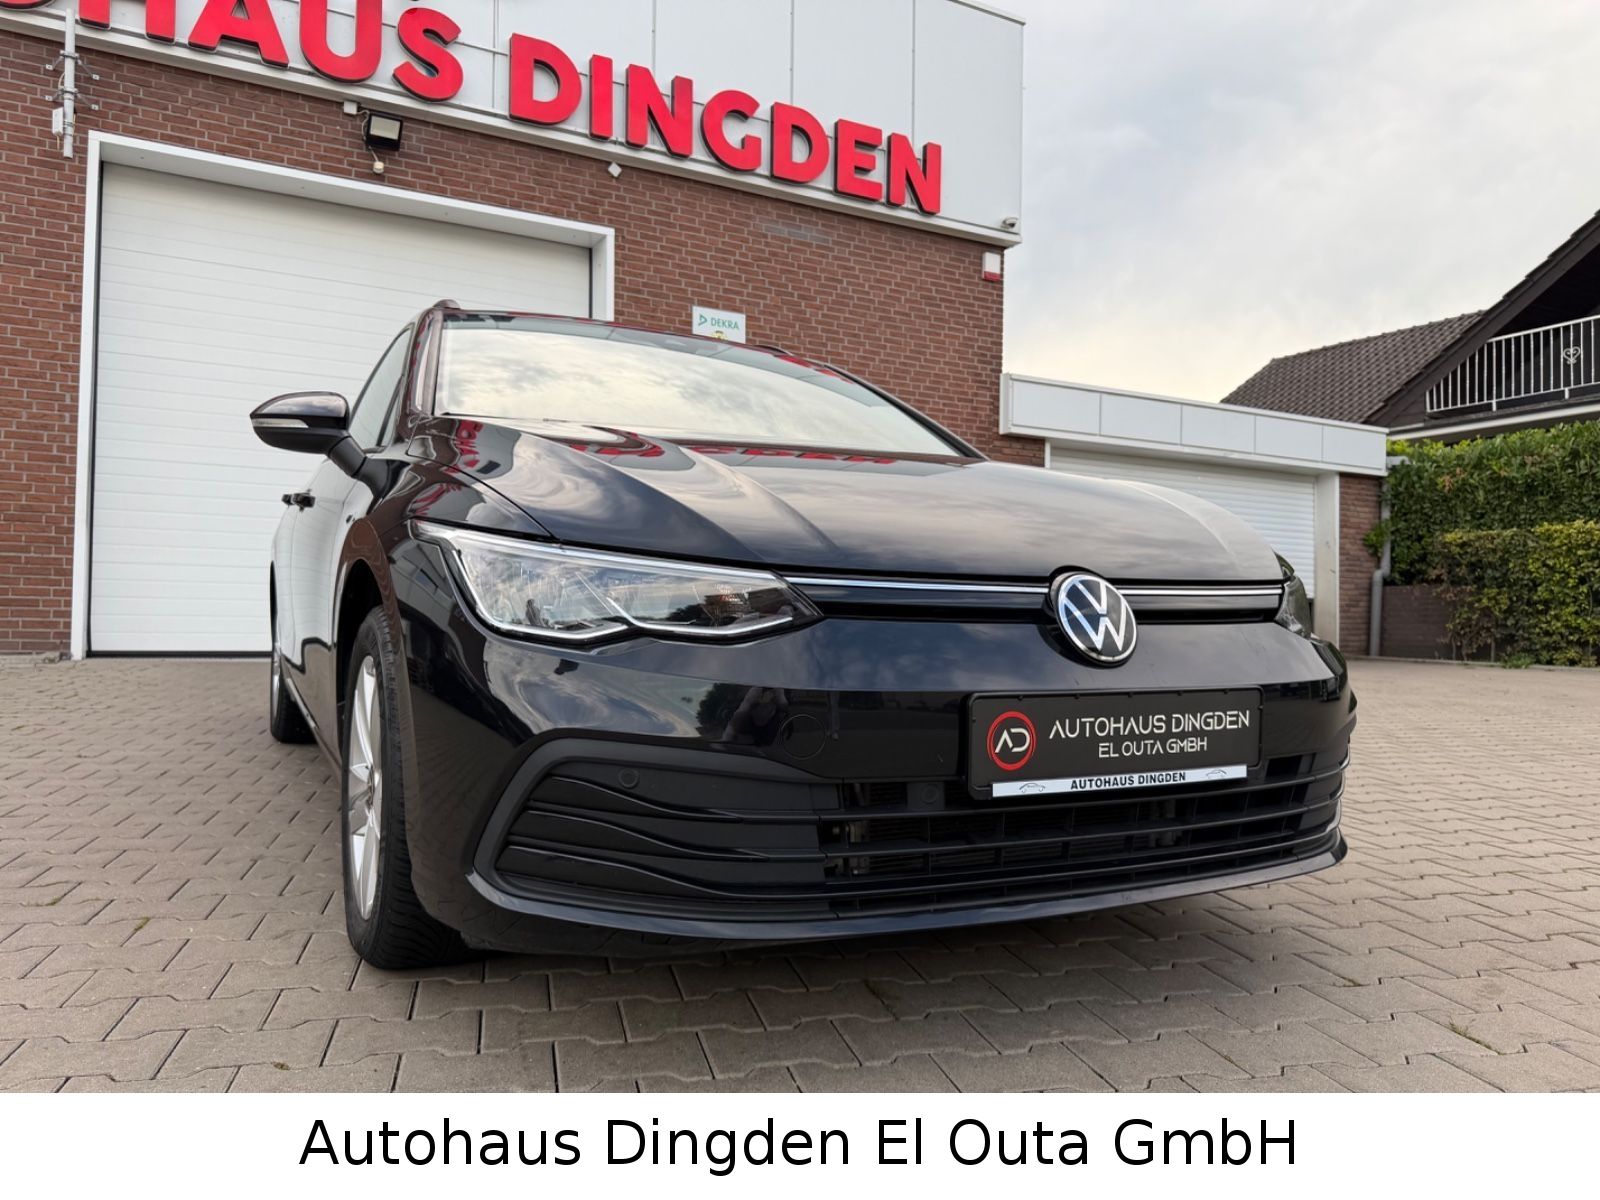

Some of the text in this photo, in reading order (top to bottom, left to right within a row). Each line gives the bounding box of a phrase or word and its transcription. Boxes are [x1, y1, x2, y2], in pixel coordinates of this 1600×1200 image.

[0, 0, 941, 215] AUS DINGDEN
[710, 317, 740, 330] DEKRA
[1060, 575, 1134, 654] VW
[1049, 710, 1250, 739] AUTOHAUS DINGDEN
[1098, 736, 1208, 758] EL OUTA GMBH
[1070, 771, 1186, 790] AUTOHAUS DINGDEN
